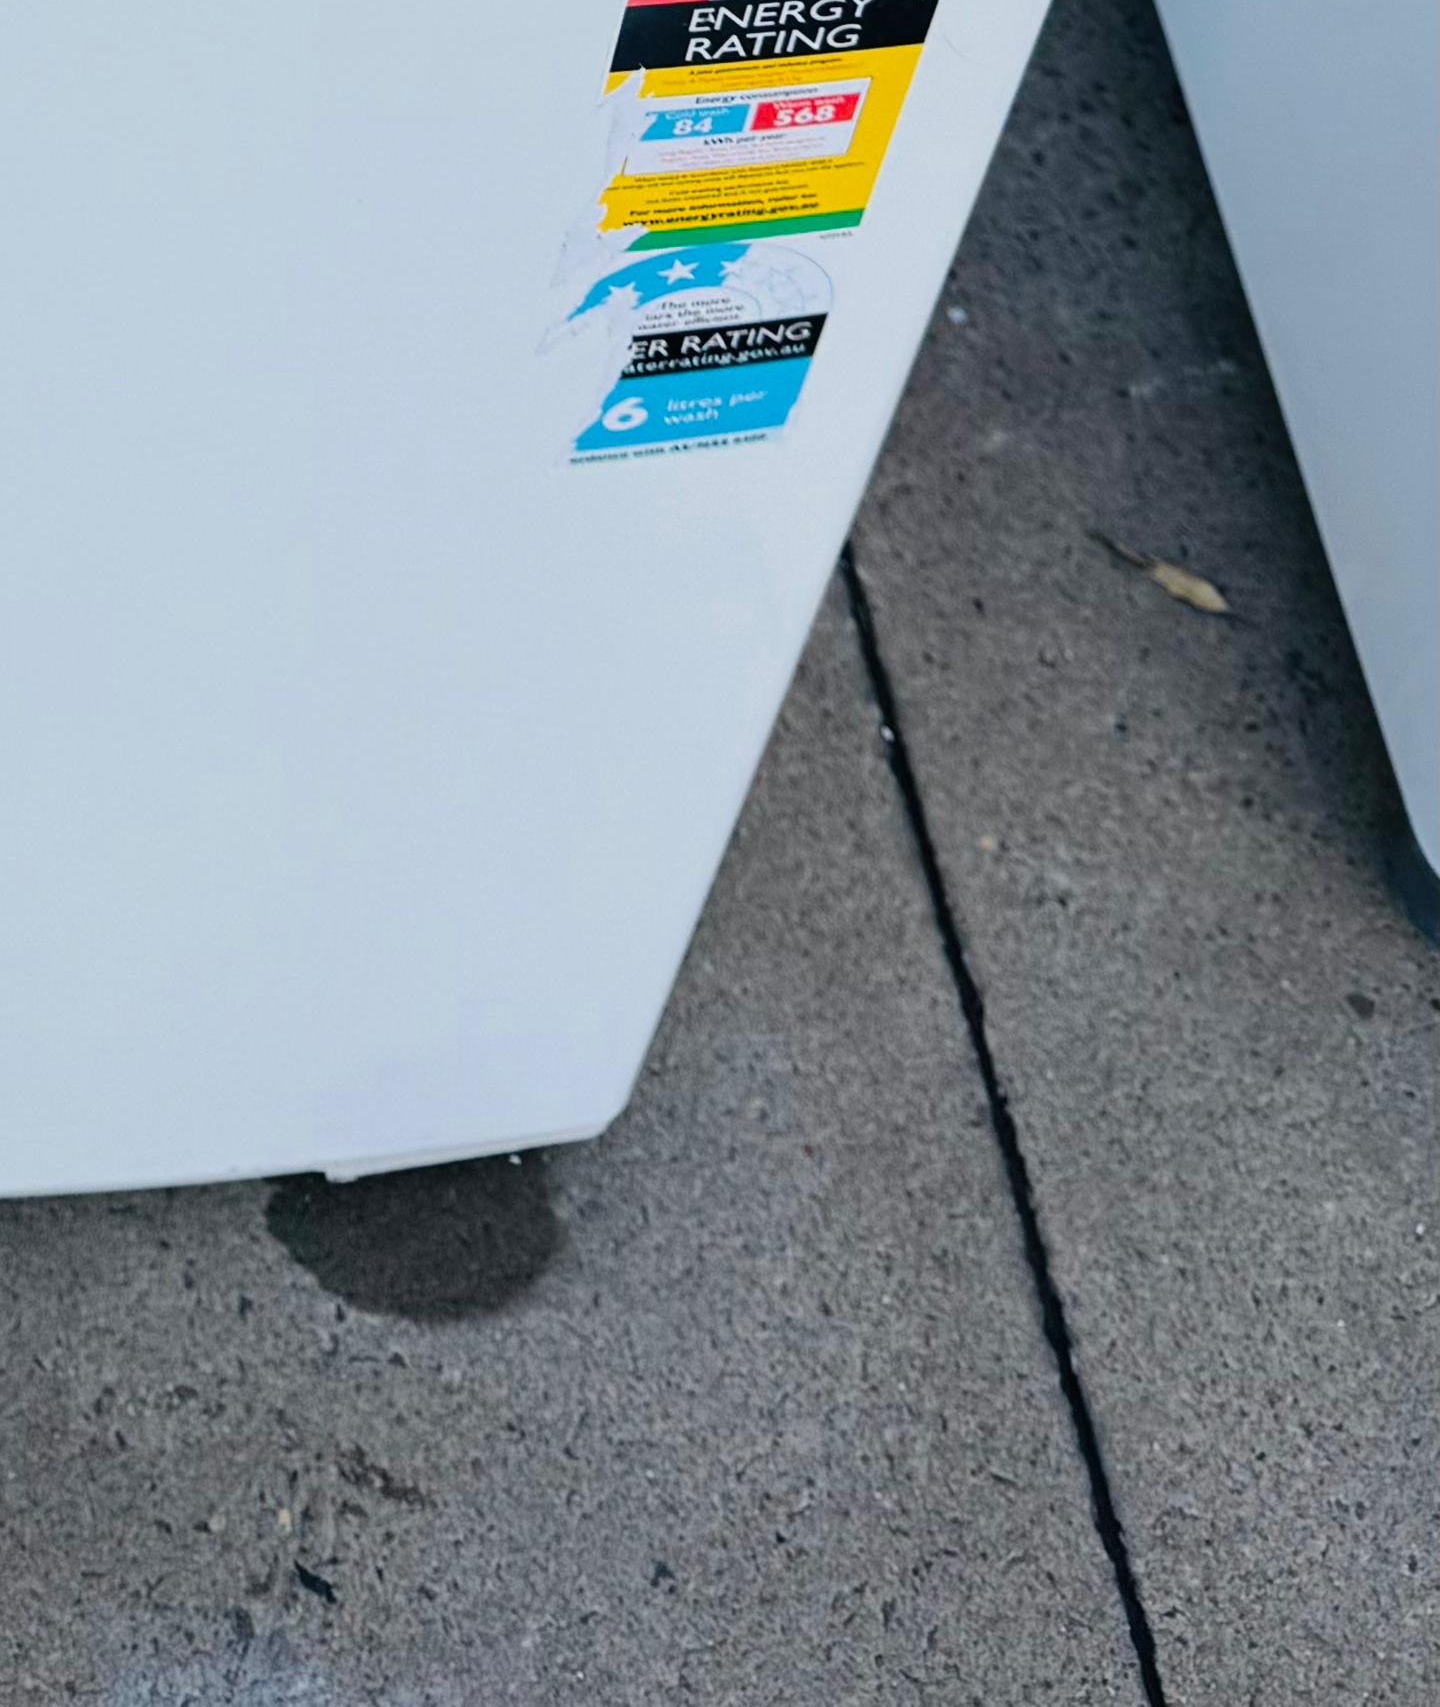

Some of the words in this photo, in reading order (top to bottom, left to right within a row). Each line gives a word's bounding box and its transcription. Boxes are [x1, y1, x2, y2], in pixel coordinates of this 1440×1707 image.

[684, 23, 862, 62] RATING
[672, 117, 713, 136] 84
[773, 104, 836, 127] 568
[681, 321, 813, 355] RATING
[602, 396, 649, 433] 6
[664, 408, 720, 426] wash
